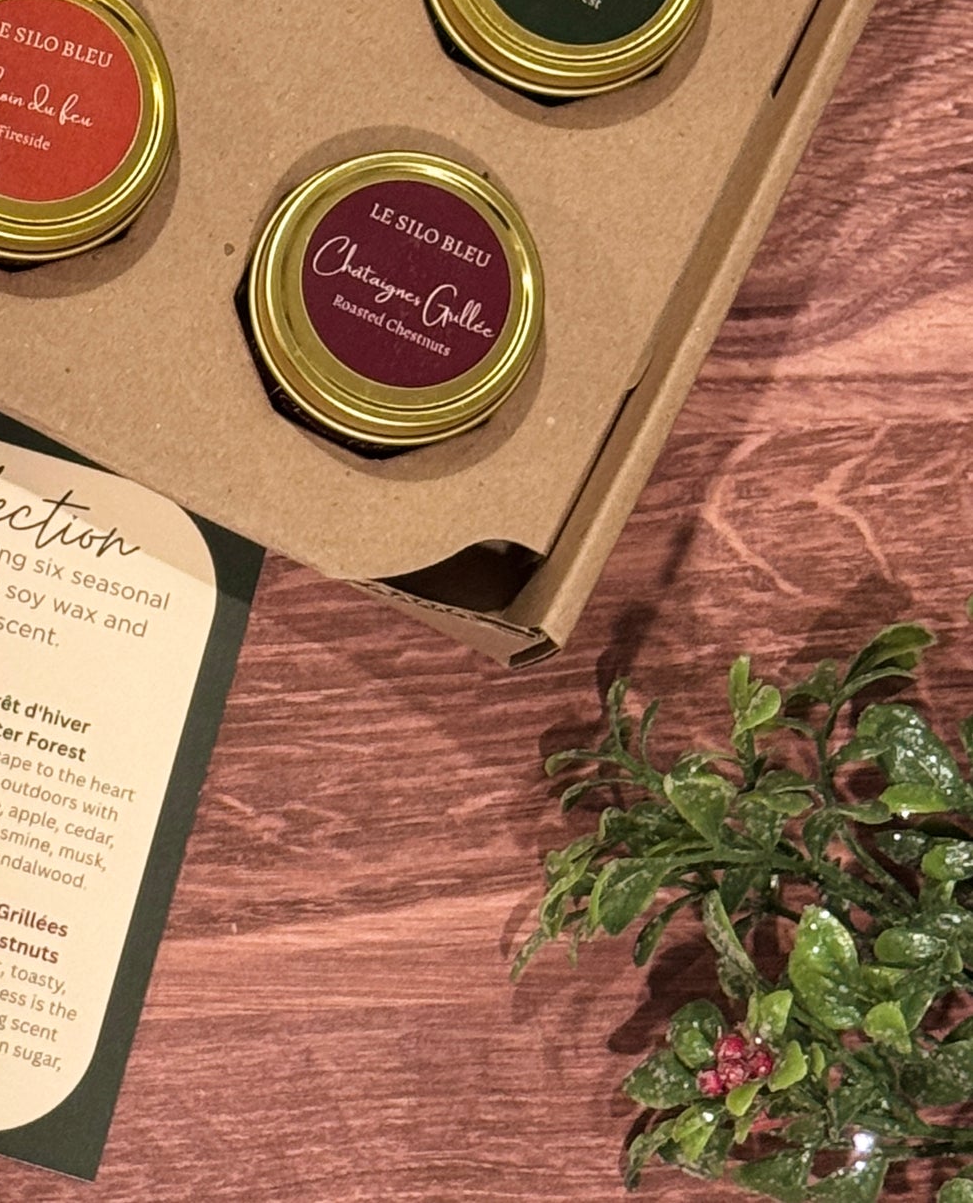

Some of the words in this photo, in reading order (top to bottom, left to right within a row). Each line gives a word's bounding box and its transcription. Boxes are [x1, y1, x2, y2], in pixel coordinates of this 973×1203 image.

[13, 26, 59, 52] SILO
[60, 40, 113, 67] BLEU
[26, 83, 56, 116] du
[58, 92, 93, 127] feu
[369, 202, 394, 225] LE
[394, 214, 439, 244] SILO
[440, 234, 491, 267] BLEU
[331, 293, 386, 327] Roasted
[385, 318, 451, 356] Chestnuts
[32, 557, 64, 580] six
[70, 570, 170, 610] seasonal
[4, 584, 46, 610] soy
[53, 597, 98, 624] wax
[103, 613, 148, 638] and
[24, 702, 91, 734] d'hiver
[25, 730, 86, 762] Forest
[35, 761, 54, 778] to
[57, 767, 86, 787] the
[89, 775, 136, 802] heart
[29, 993, 45, 1012] is
[48, 1001, 77, 1021] the
